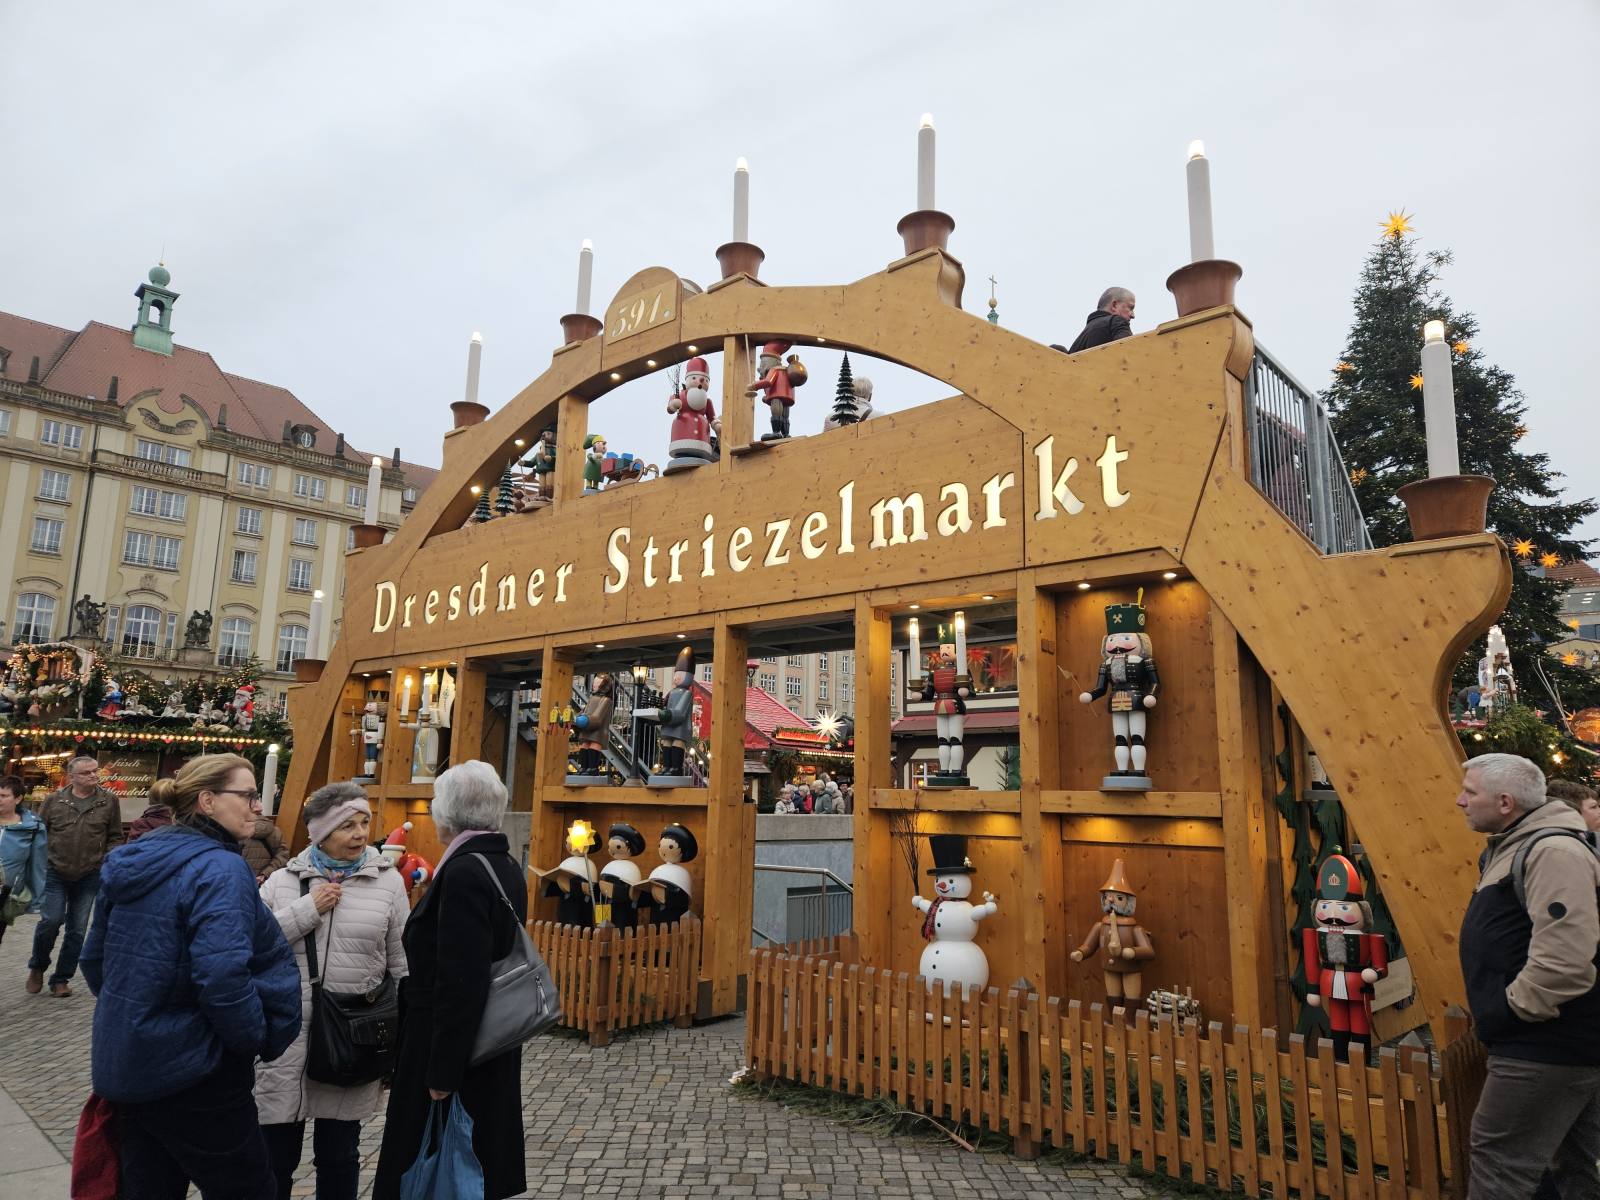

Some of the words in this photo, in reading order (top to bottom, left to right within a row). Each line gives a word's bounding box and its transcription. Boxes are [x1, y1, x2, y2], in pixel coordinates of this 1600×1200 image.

[611, 291, 671, 337] 591.
[372, 560, 574, 634] Dresdner
[603, 434, 1131, 595] Striezelmarkt
